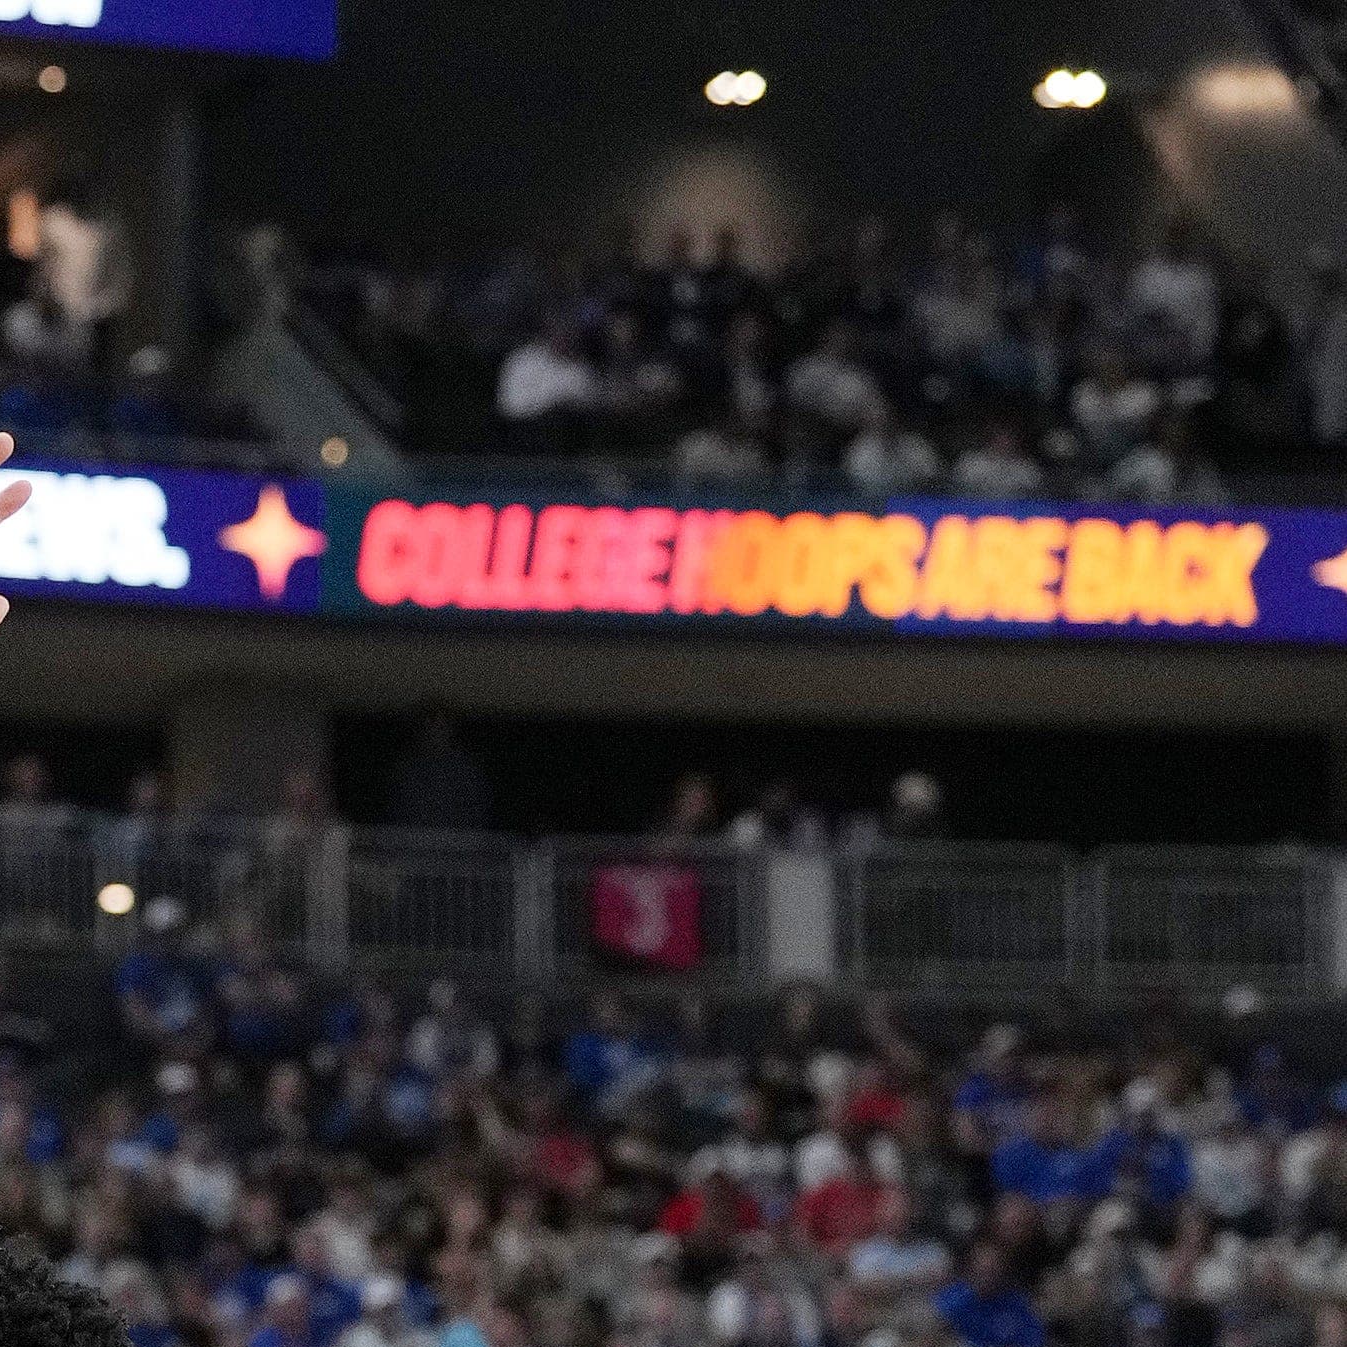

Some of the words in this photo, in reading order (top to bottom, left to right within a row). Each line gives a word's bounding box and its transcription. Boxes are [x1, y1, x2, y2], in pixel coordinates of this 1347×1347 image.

[357, 500, 675, 614] COLLEGE
[671, 510, 927, 618] HOOPS
[919, 514, 1068, 622] ARE
[1059, 518, 1270, 627] BACK
